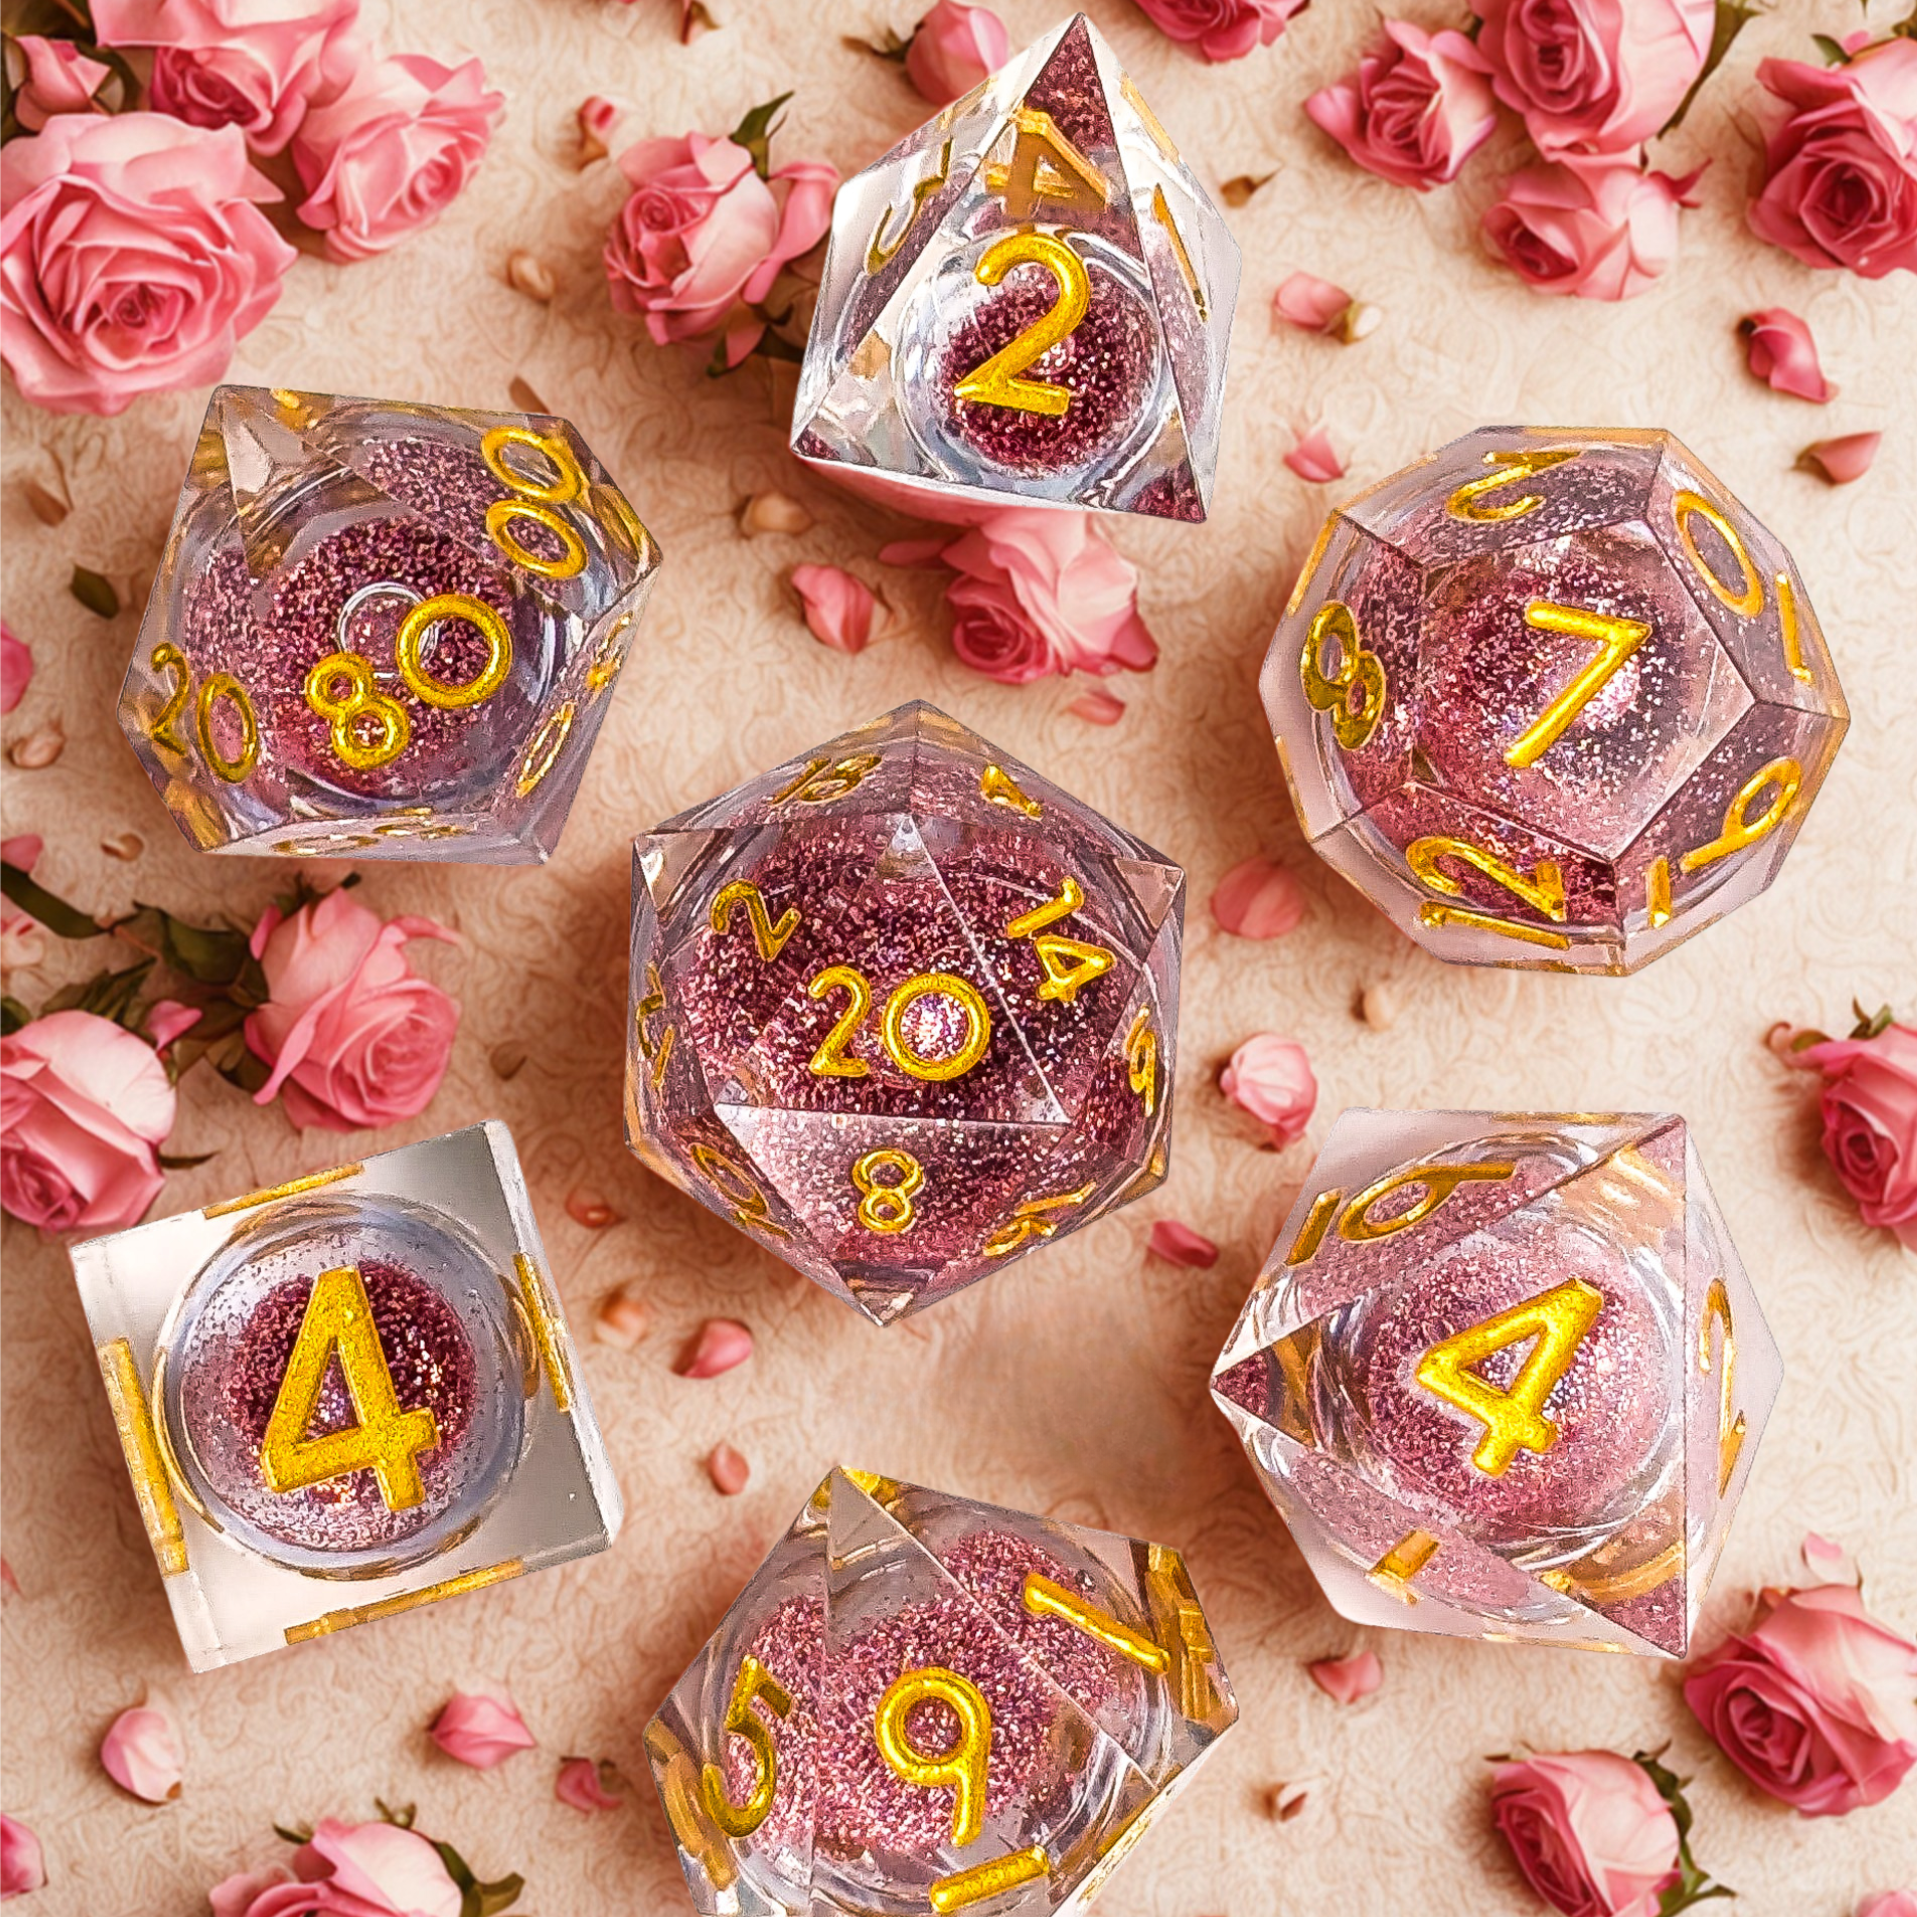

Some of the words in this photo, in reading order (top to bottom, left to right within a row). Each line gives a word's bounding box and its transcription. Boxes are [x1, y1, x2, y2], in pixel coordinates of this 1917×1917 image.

[954, 231, 1089, 417] 2
[151, 642, 259, 785] 20
[305, 593, 514, 770] 80
[1300, 601, 1387, 750] 8
[1501, 600, 1653, 768] 7
[709, 880, 802, 962] 2
[1007, 875, 1118, 1002] 14
[808, 965, 992, 1082] 20
[852, 1149, 925, 1234] 8
[261, 1265, 440, 1512] 4
[1416, 1277, 1604, 1478] 4
[702, 1654, 793, 1838] 5
[874, 1666, 992, 1847] 9
